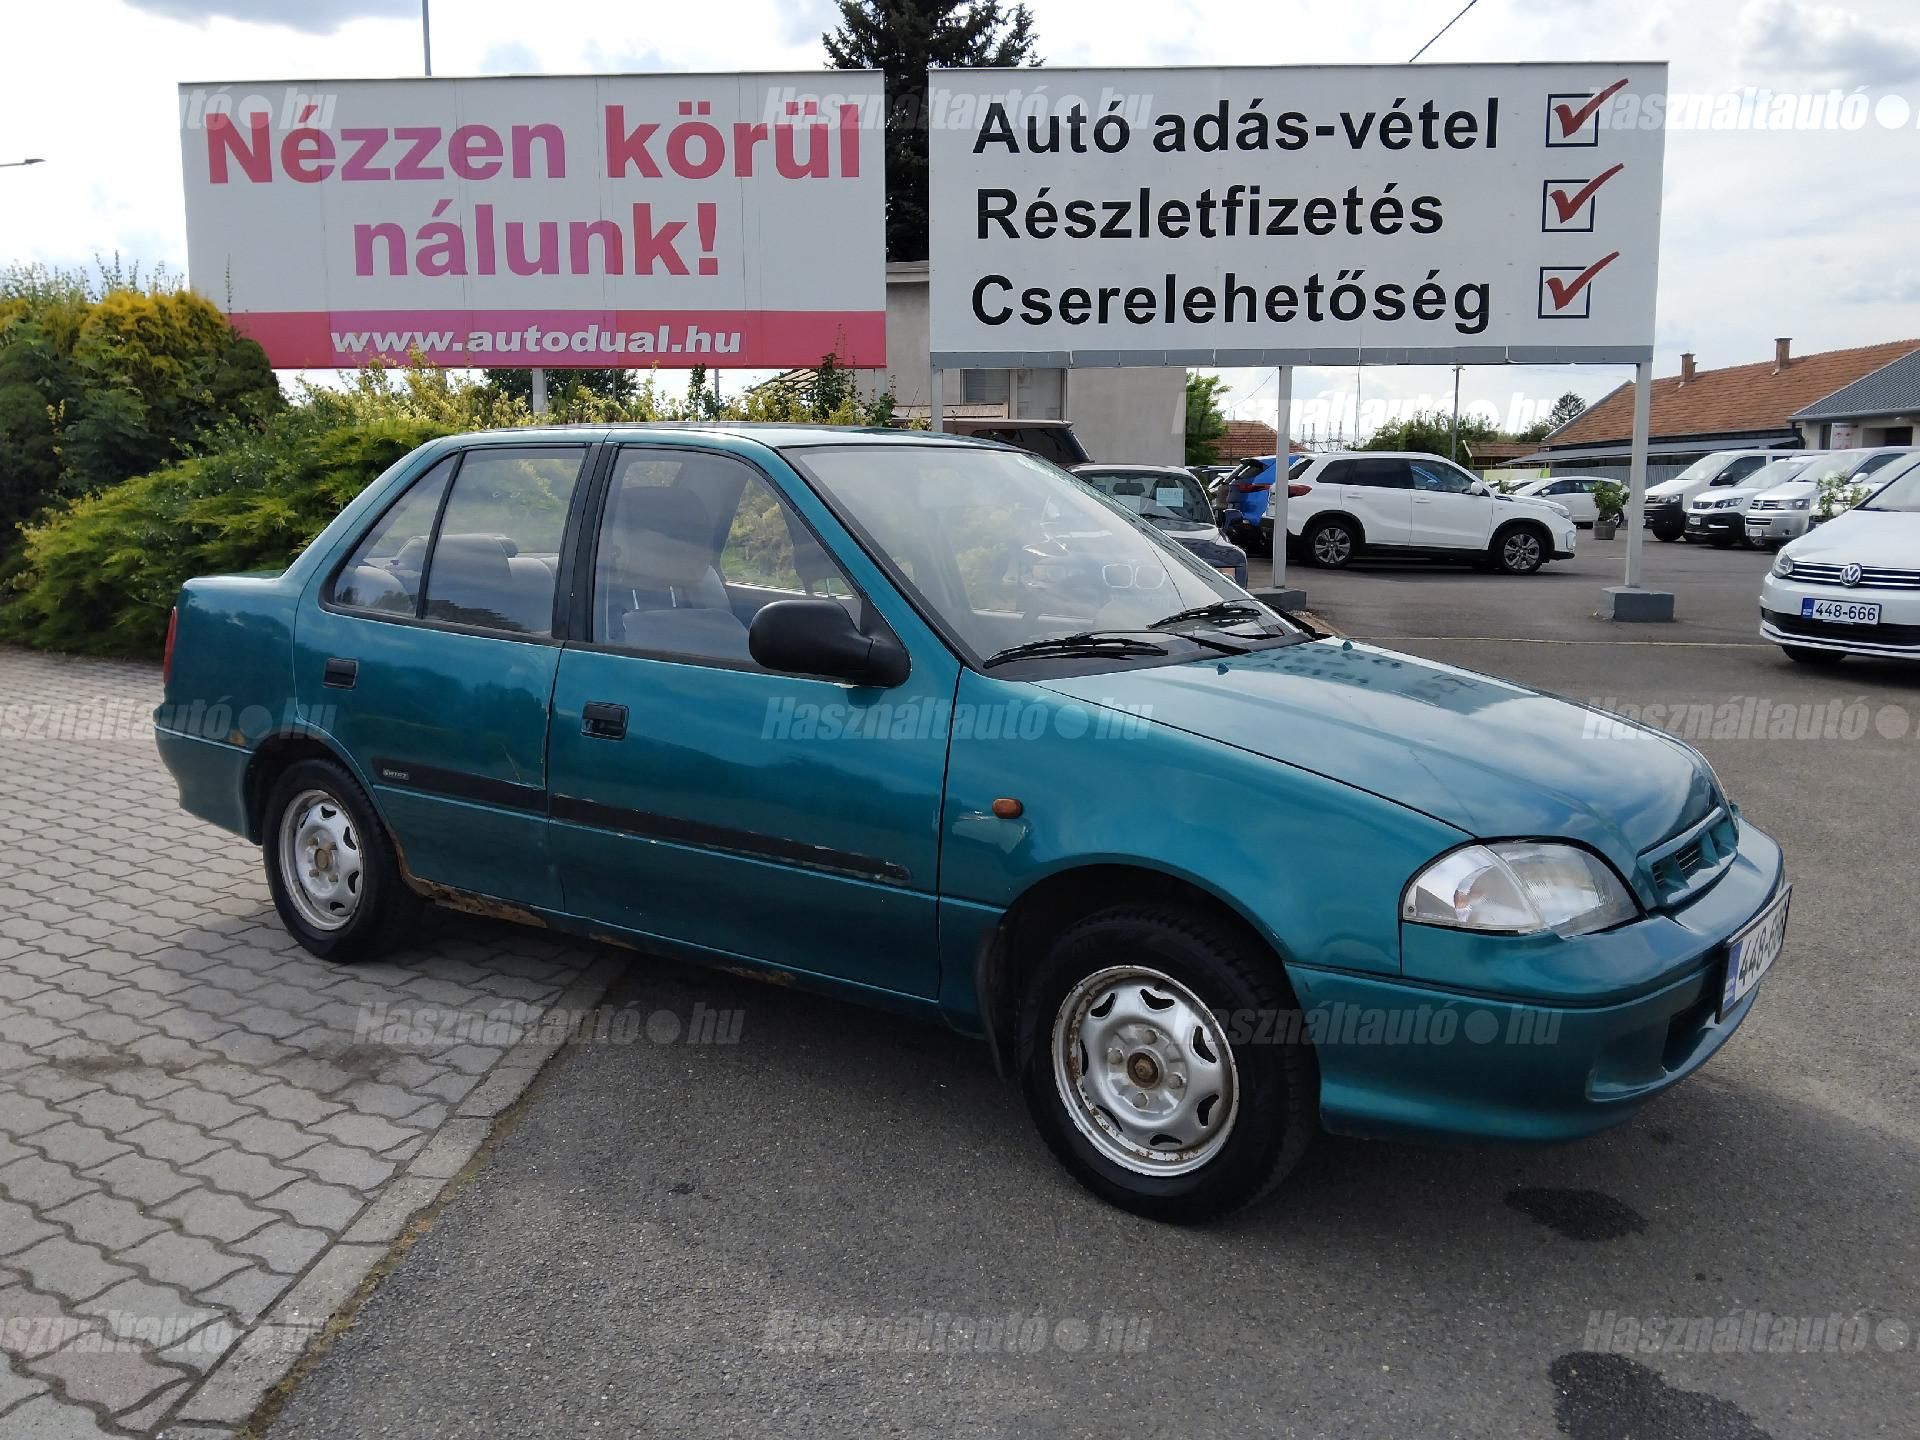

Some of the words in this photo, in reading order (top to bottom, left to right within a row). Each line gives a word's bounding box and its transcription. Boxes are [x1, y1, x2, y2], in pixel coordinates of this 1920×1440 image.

[207, 104, 566, 184] Nézzen
[605, 101, 861, 179] körül
[972, 101, 1131, 155] Autó
[1153, 97, 1499, 153] adás-vétel
[354, 199, 719, 276] nálunk!
[976, 183, 1444, 240] Részletfizetés
[972, 269, 1491, 335] Cserelehetőség
[331, 323, 741, 356] www.autodual.hu
[1815, 602, 1876, 621] 448-666
